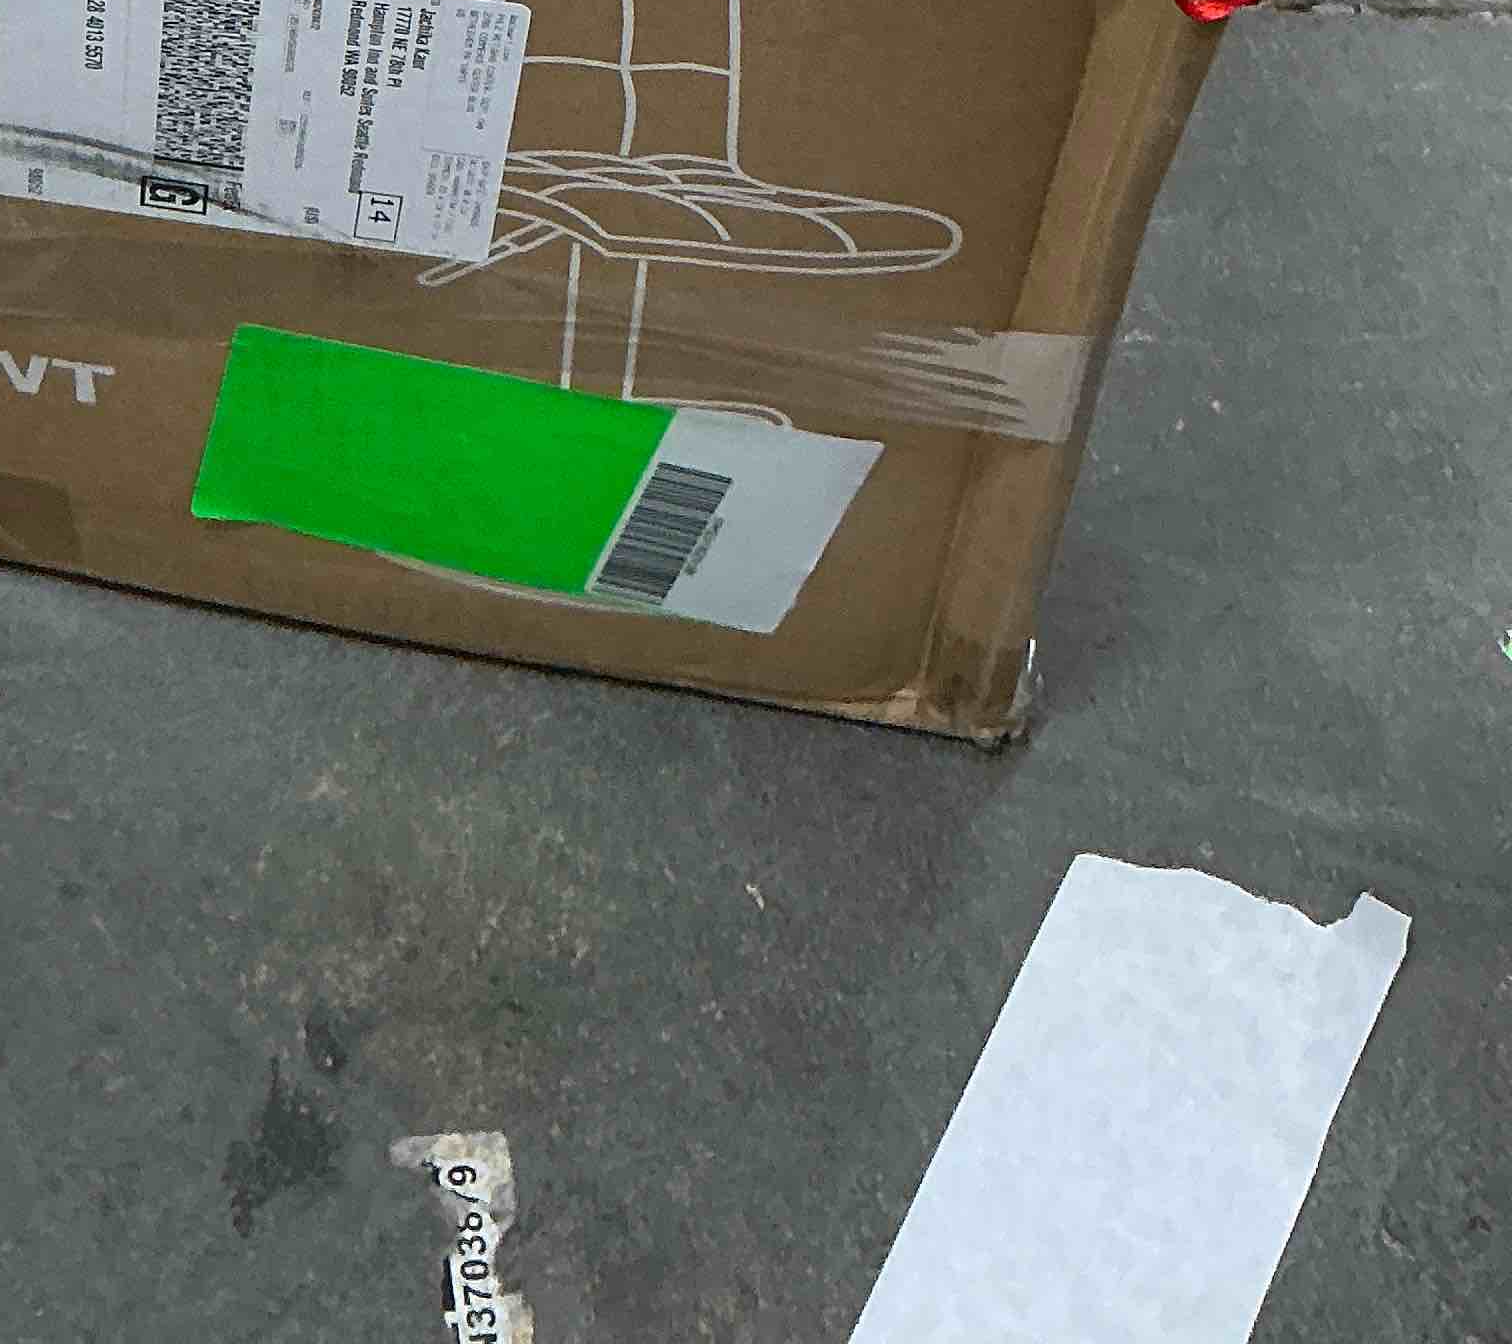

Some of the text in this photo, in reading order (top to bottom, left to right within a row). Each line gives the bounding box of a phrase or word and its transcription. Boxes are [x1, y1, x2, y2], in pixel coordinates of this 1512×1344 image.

[85, 15, 104, 42] 4013
[391, 37, 409, 53] NE
[344, 50, 361, 65] WA
